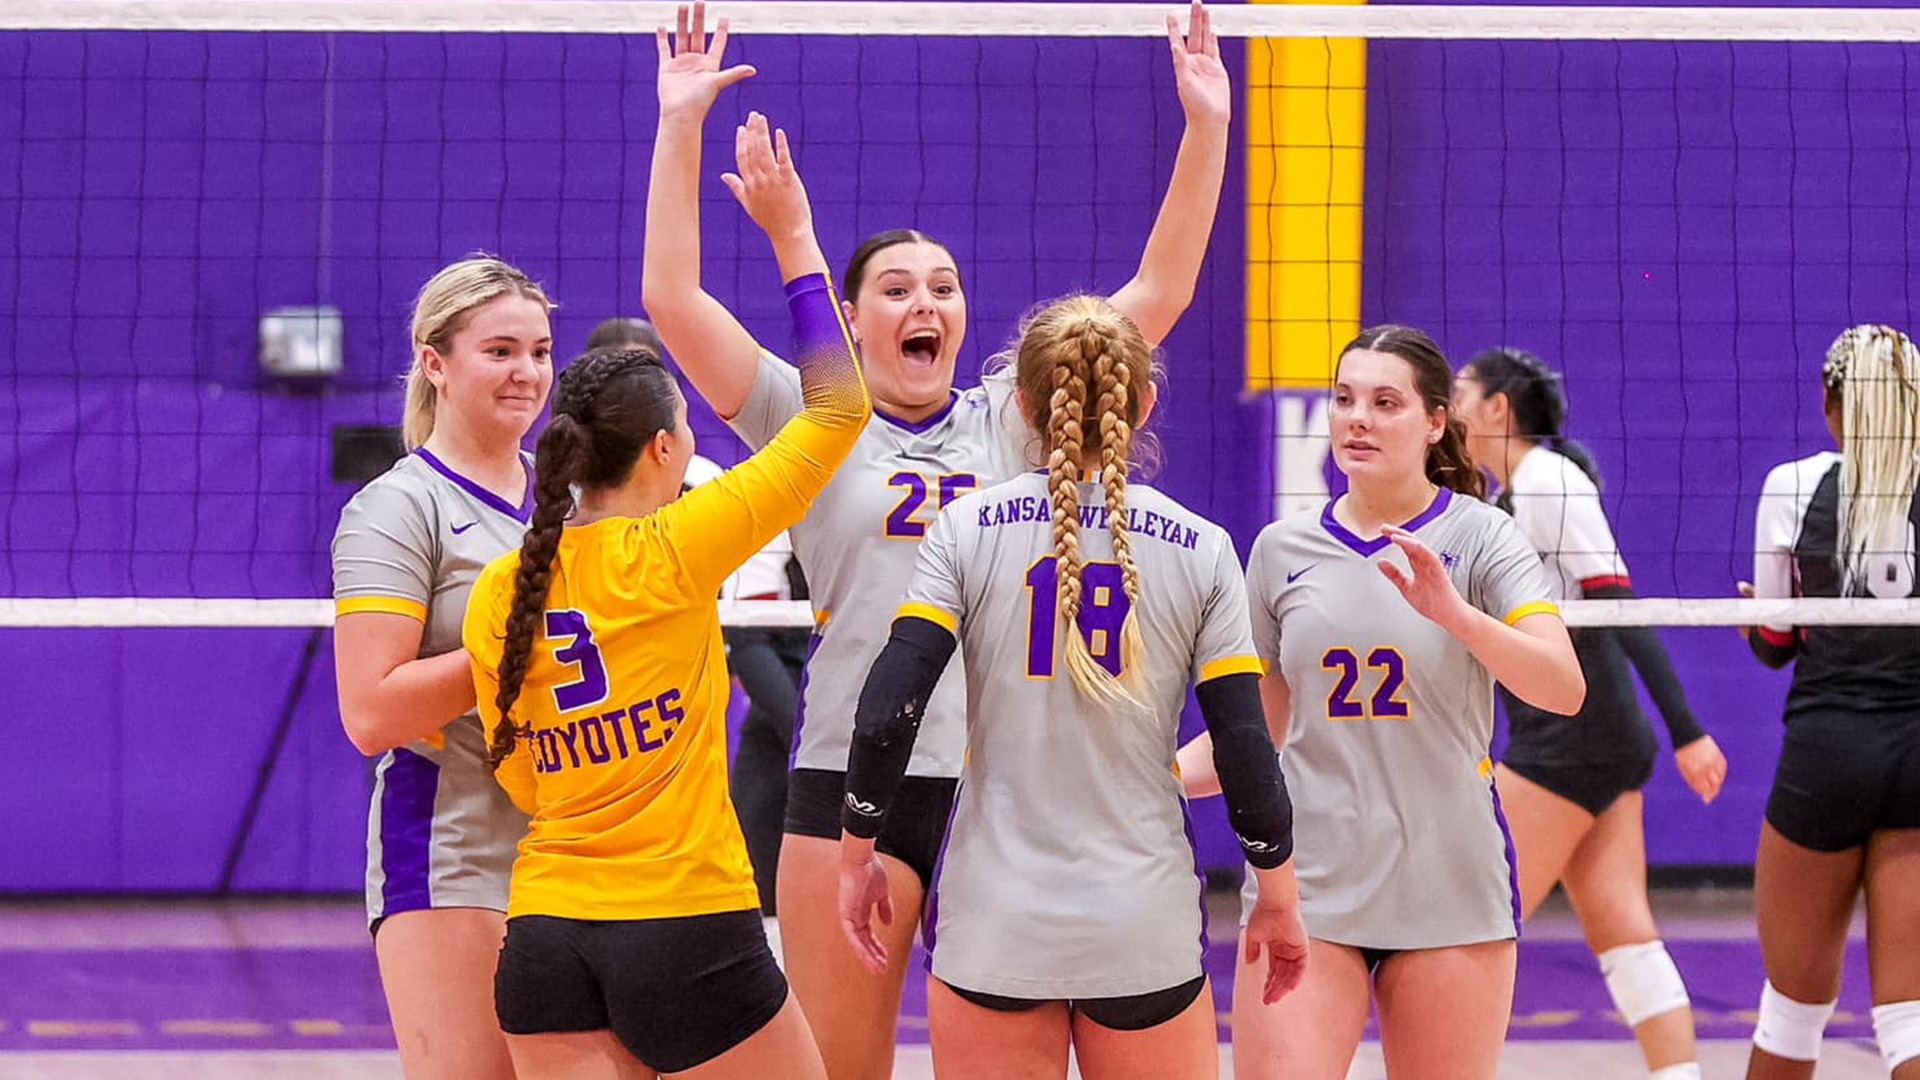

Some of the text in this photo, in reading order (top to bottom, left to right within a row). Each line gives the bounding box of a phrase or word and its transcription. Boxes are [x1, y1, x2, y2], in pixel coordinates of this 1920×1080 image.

[978, 496, 1200, 550] KANSA WELEYAN
[543, 607, 611, 714] 3
[1024, 553, 1139, 680] 18
[1320, 644, 1412, 721] 22
